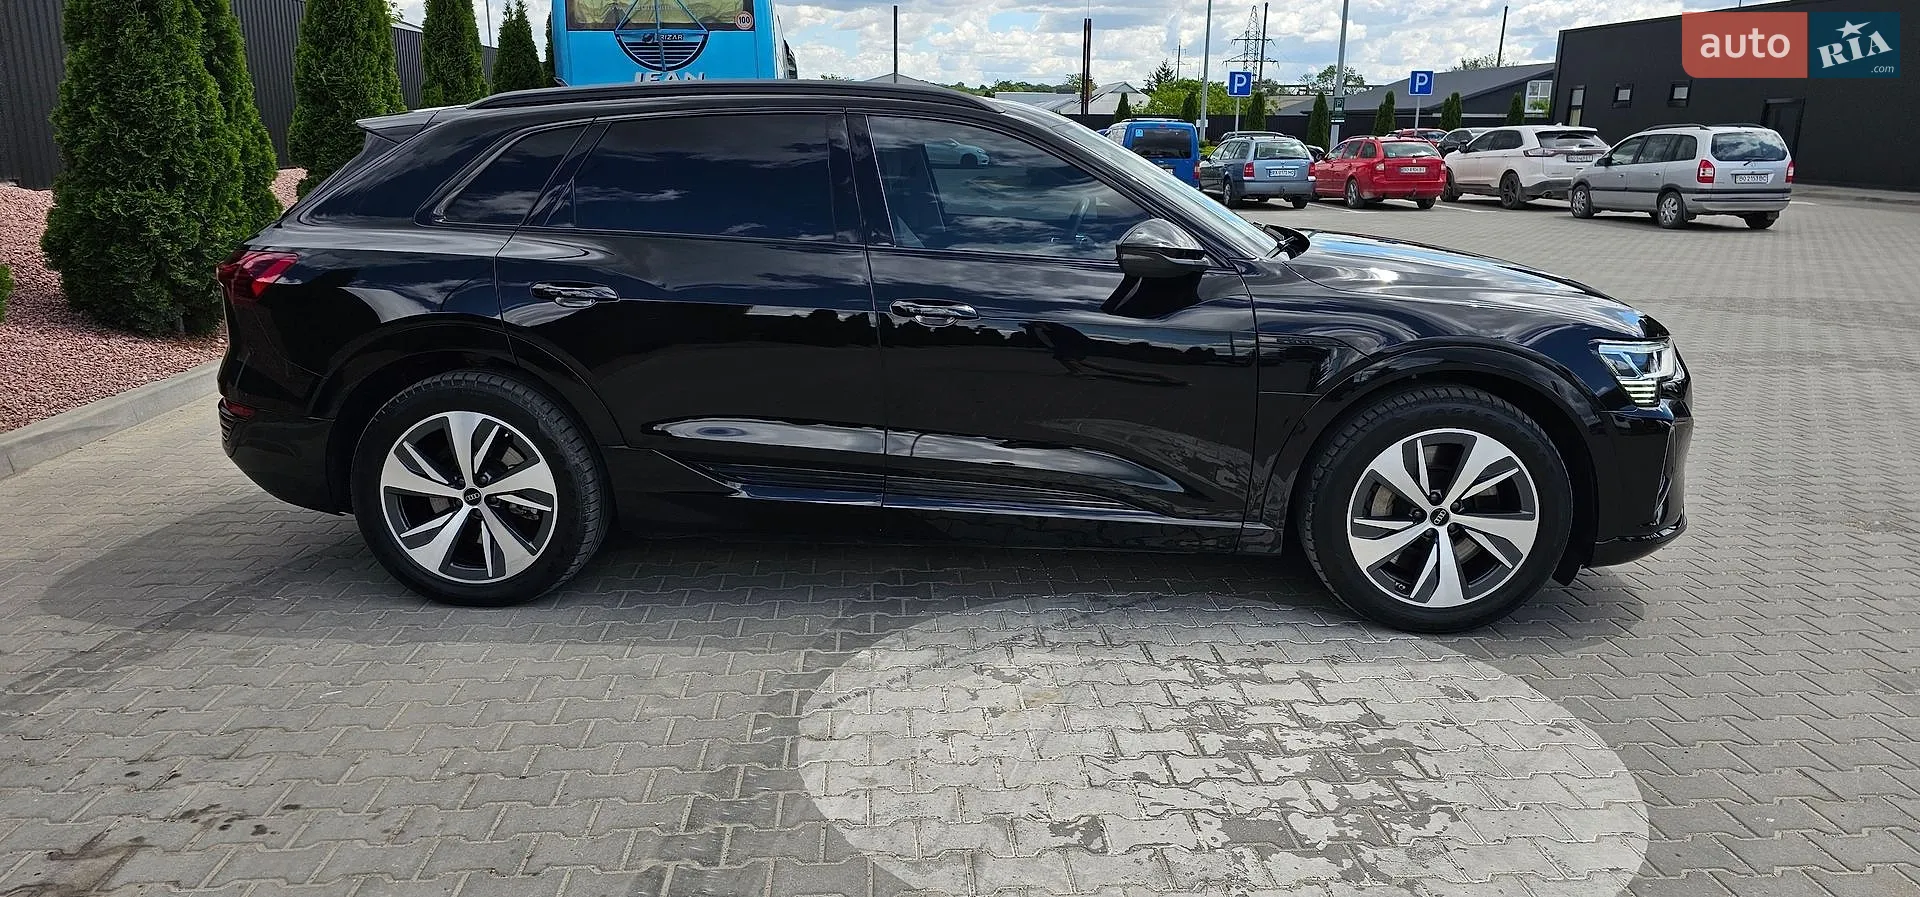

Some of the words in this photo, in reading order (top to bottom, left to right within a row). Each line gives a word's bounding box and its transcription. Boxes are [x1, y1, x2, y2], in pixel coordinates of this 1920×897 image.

[738, 16, 750, 24] 100
[1234, 74, 1246, 93] P
[1415, 73, 1428, 92] P
